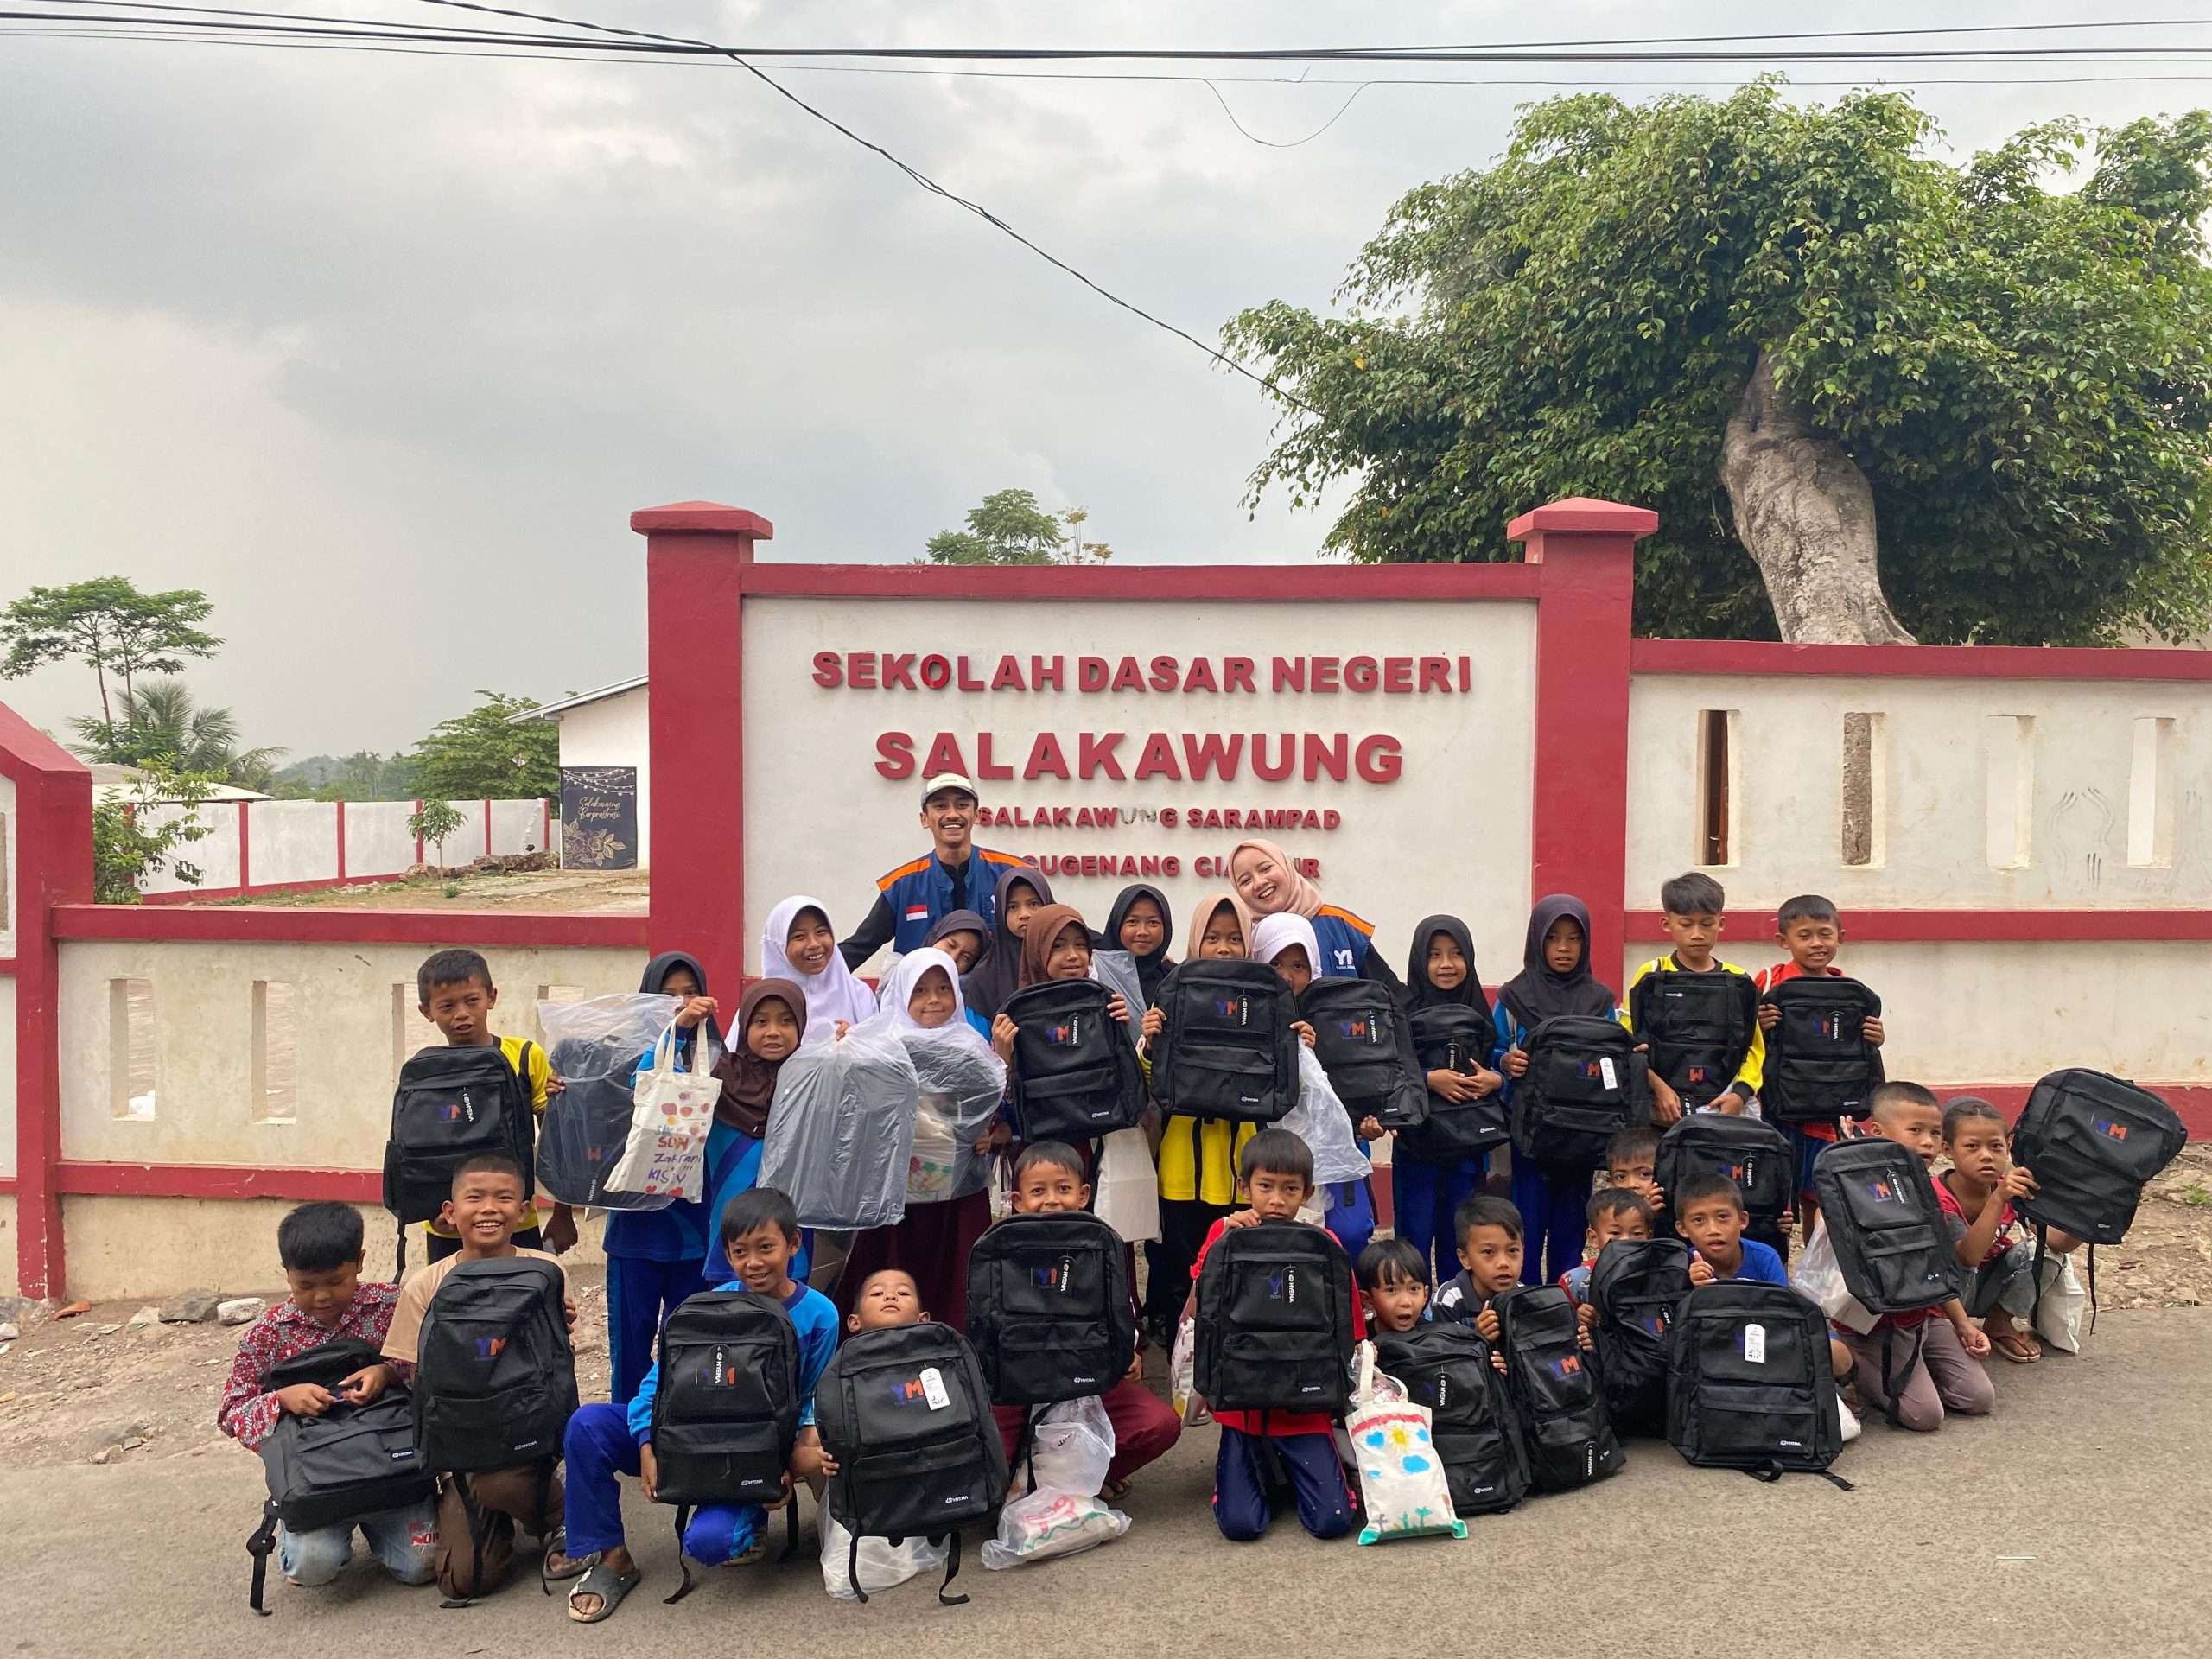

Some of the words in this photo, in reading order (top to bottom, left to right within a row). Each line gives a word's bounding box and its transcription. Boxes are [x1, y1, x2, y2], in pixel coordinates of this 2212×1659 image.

[812, 651, 1065, 692] SEKOLAH
[1078, 655, 1256, 693] DASAR
[1272, 655, 1471, 694] NEGERI
[874, 731, 1404, 784] SALAKAWUNG
[1187, 808, 1342, 831] SARAMPAD
[715, 1361, 723, 1384] HYENA
[890, 1380, 924, 1402] YM
